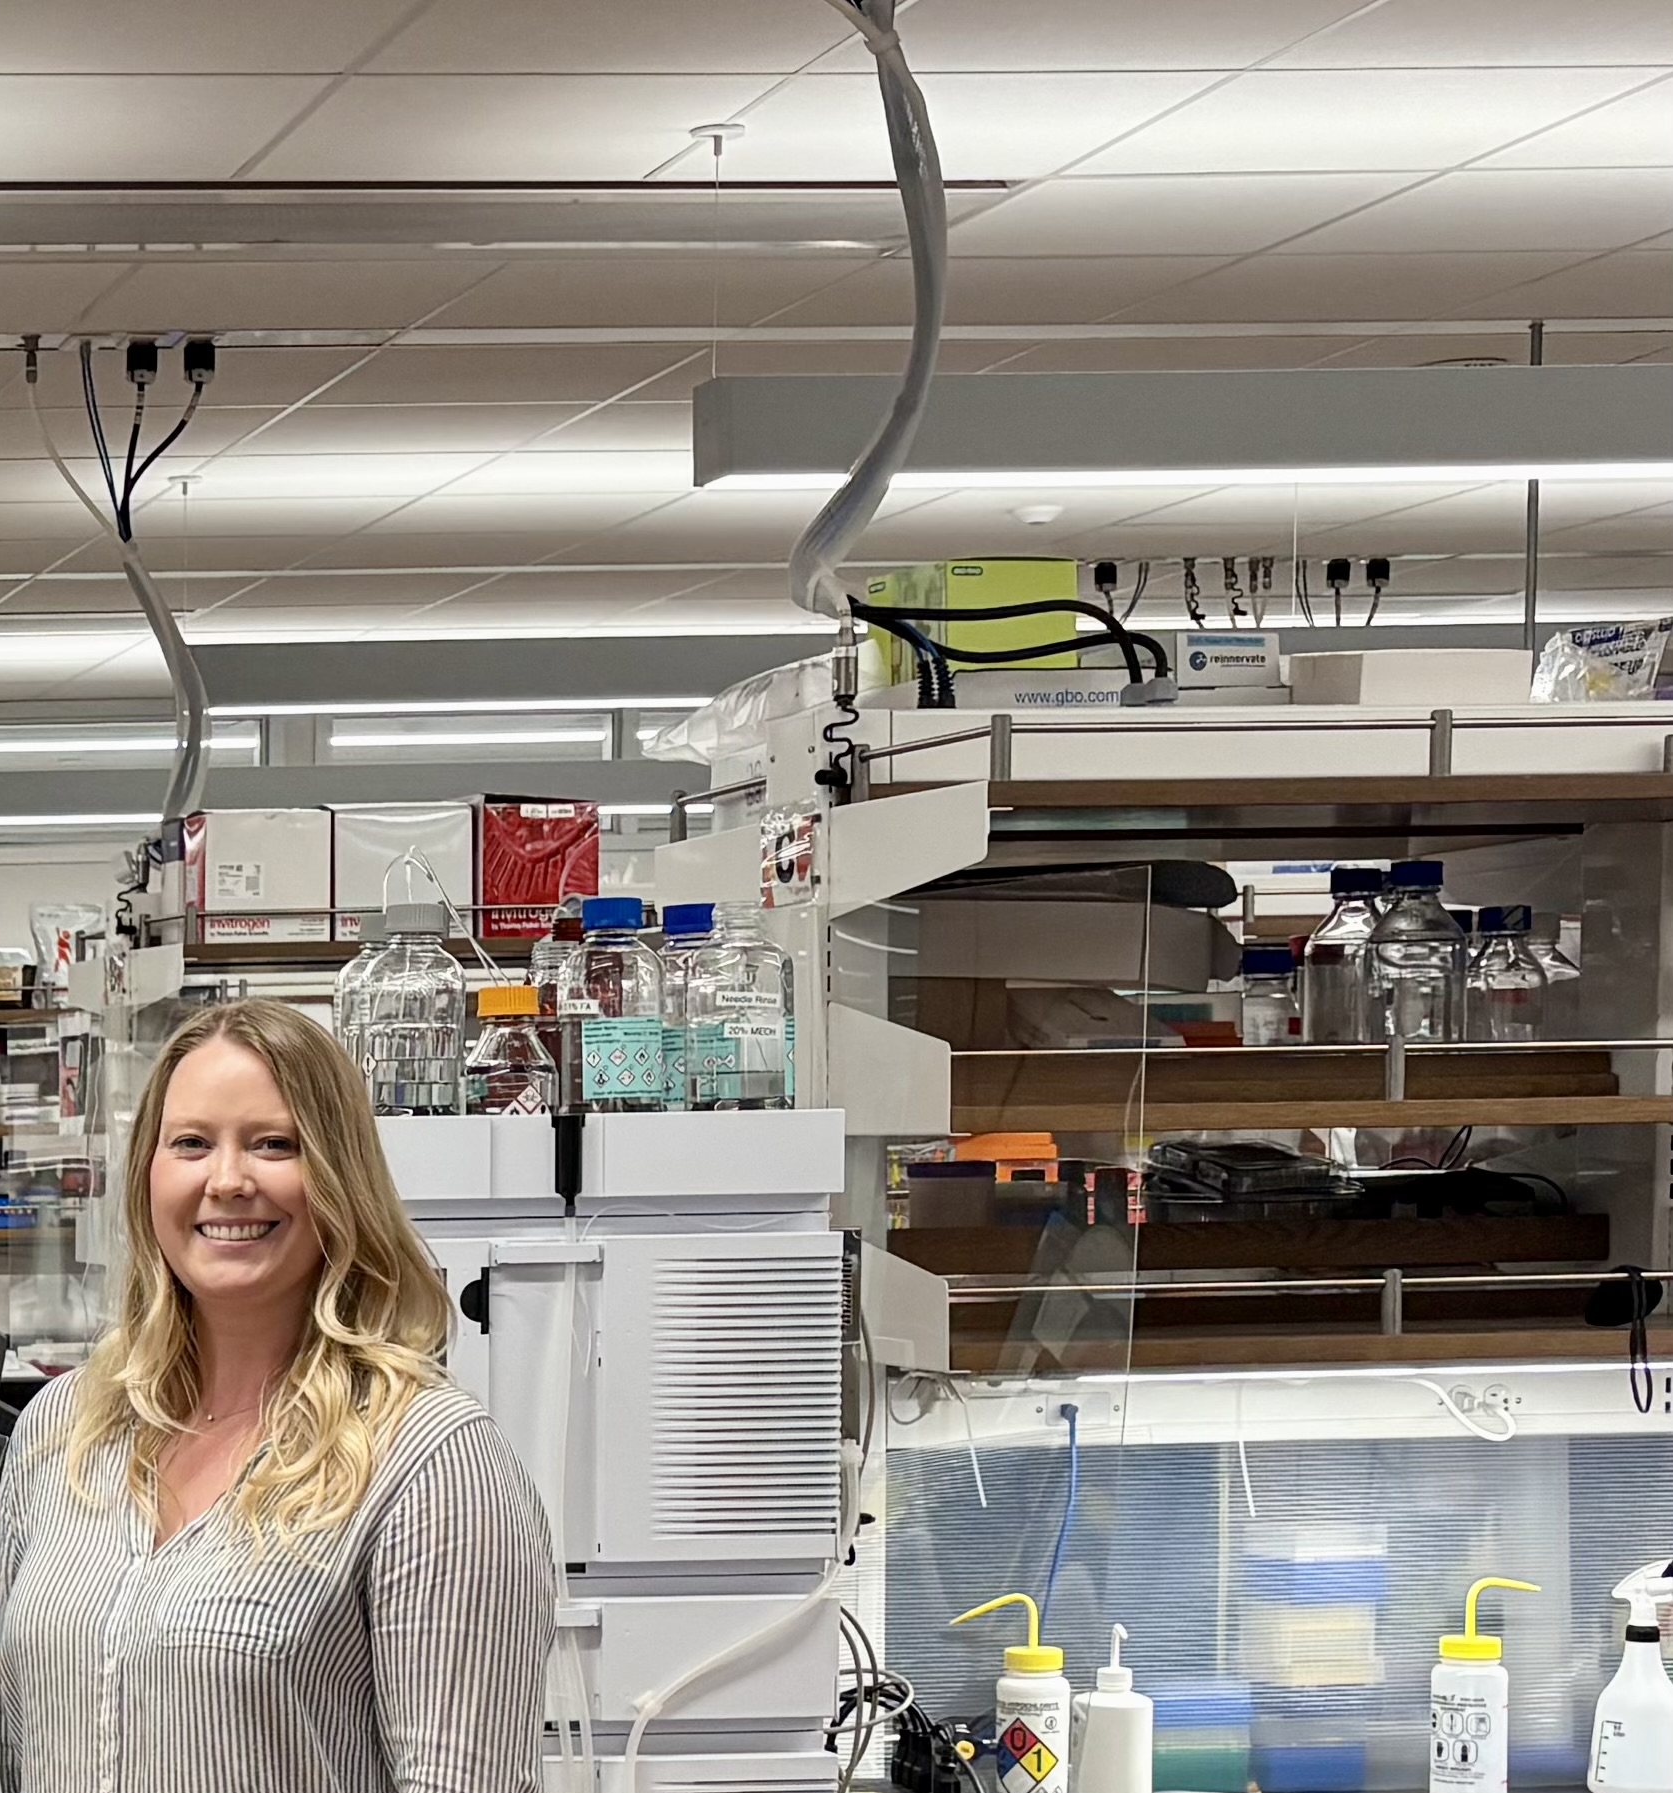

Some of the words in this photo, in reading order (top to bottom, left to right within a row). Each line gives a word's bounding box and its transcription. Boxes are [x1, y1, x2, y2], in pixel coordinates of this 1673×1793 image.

[1209, 654, 1267, 664] reinnervate
[1014, 689, 1119, 706] www.gbo.com
[210, 917, 271, 930] invitrogen
[1010, 1727, 1026, 1751] 0
[1032, 1747, 1042, 1773] 1
